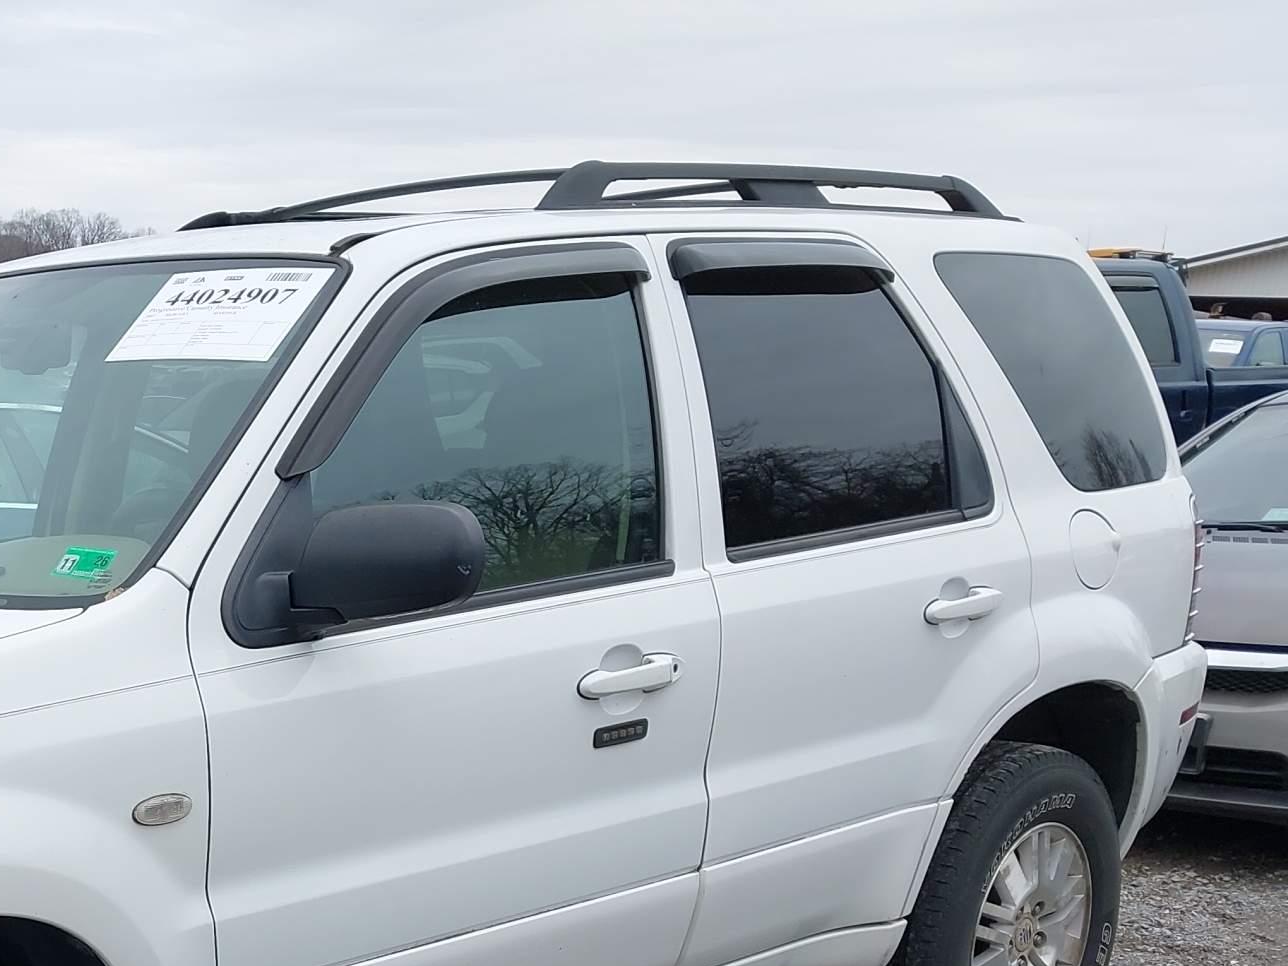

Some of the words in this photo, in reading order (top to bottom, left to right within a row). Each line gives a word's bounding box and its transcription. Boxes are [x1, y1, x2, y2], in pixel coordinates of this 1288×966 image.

[165, 287, 300, 306] 44024907
[59, 557, 78, 571] 11
[94, 555, 111, 568] 26
